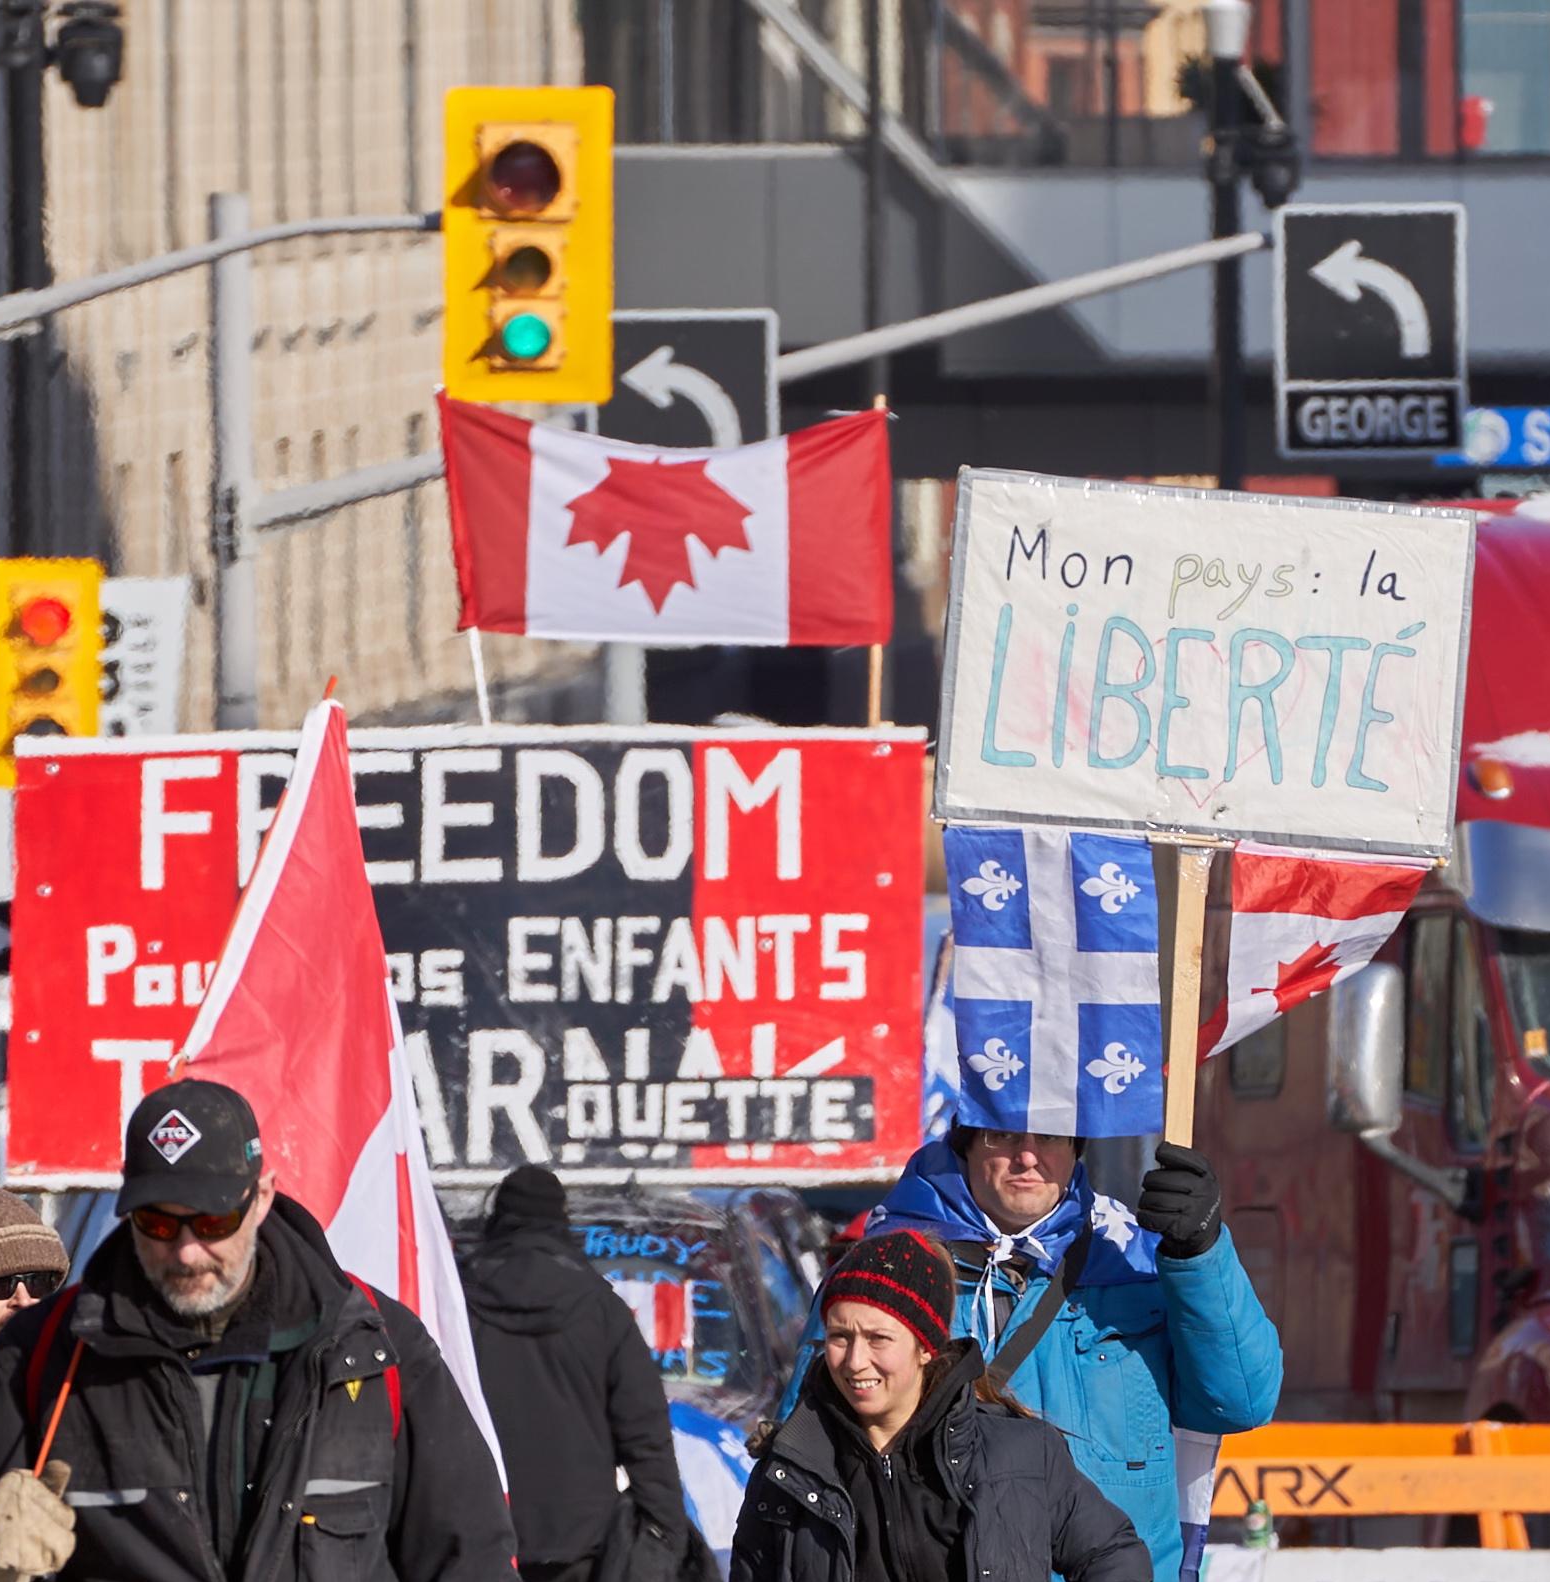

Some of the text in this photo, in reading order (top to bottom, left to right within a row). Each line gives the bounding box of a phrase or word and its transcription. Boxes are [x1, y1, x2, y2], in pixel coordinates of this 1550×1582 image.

[1298, 394, 1450, 444] GEORGE
[1004, 523, 1135, 590] Mon
[1359, 549, 1408, 602] la
[86, 924, 216, 1006] Pou
[507, 913, 869, 1003] ENFANTS
